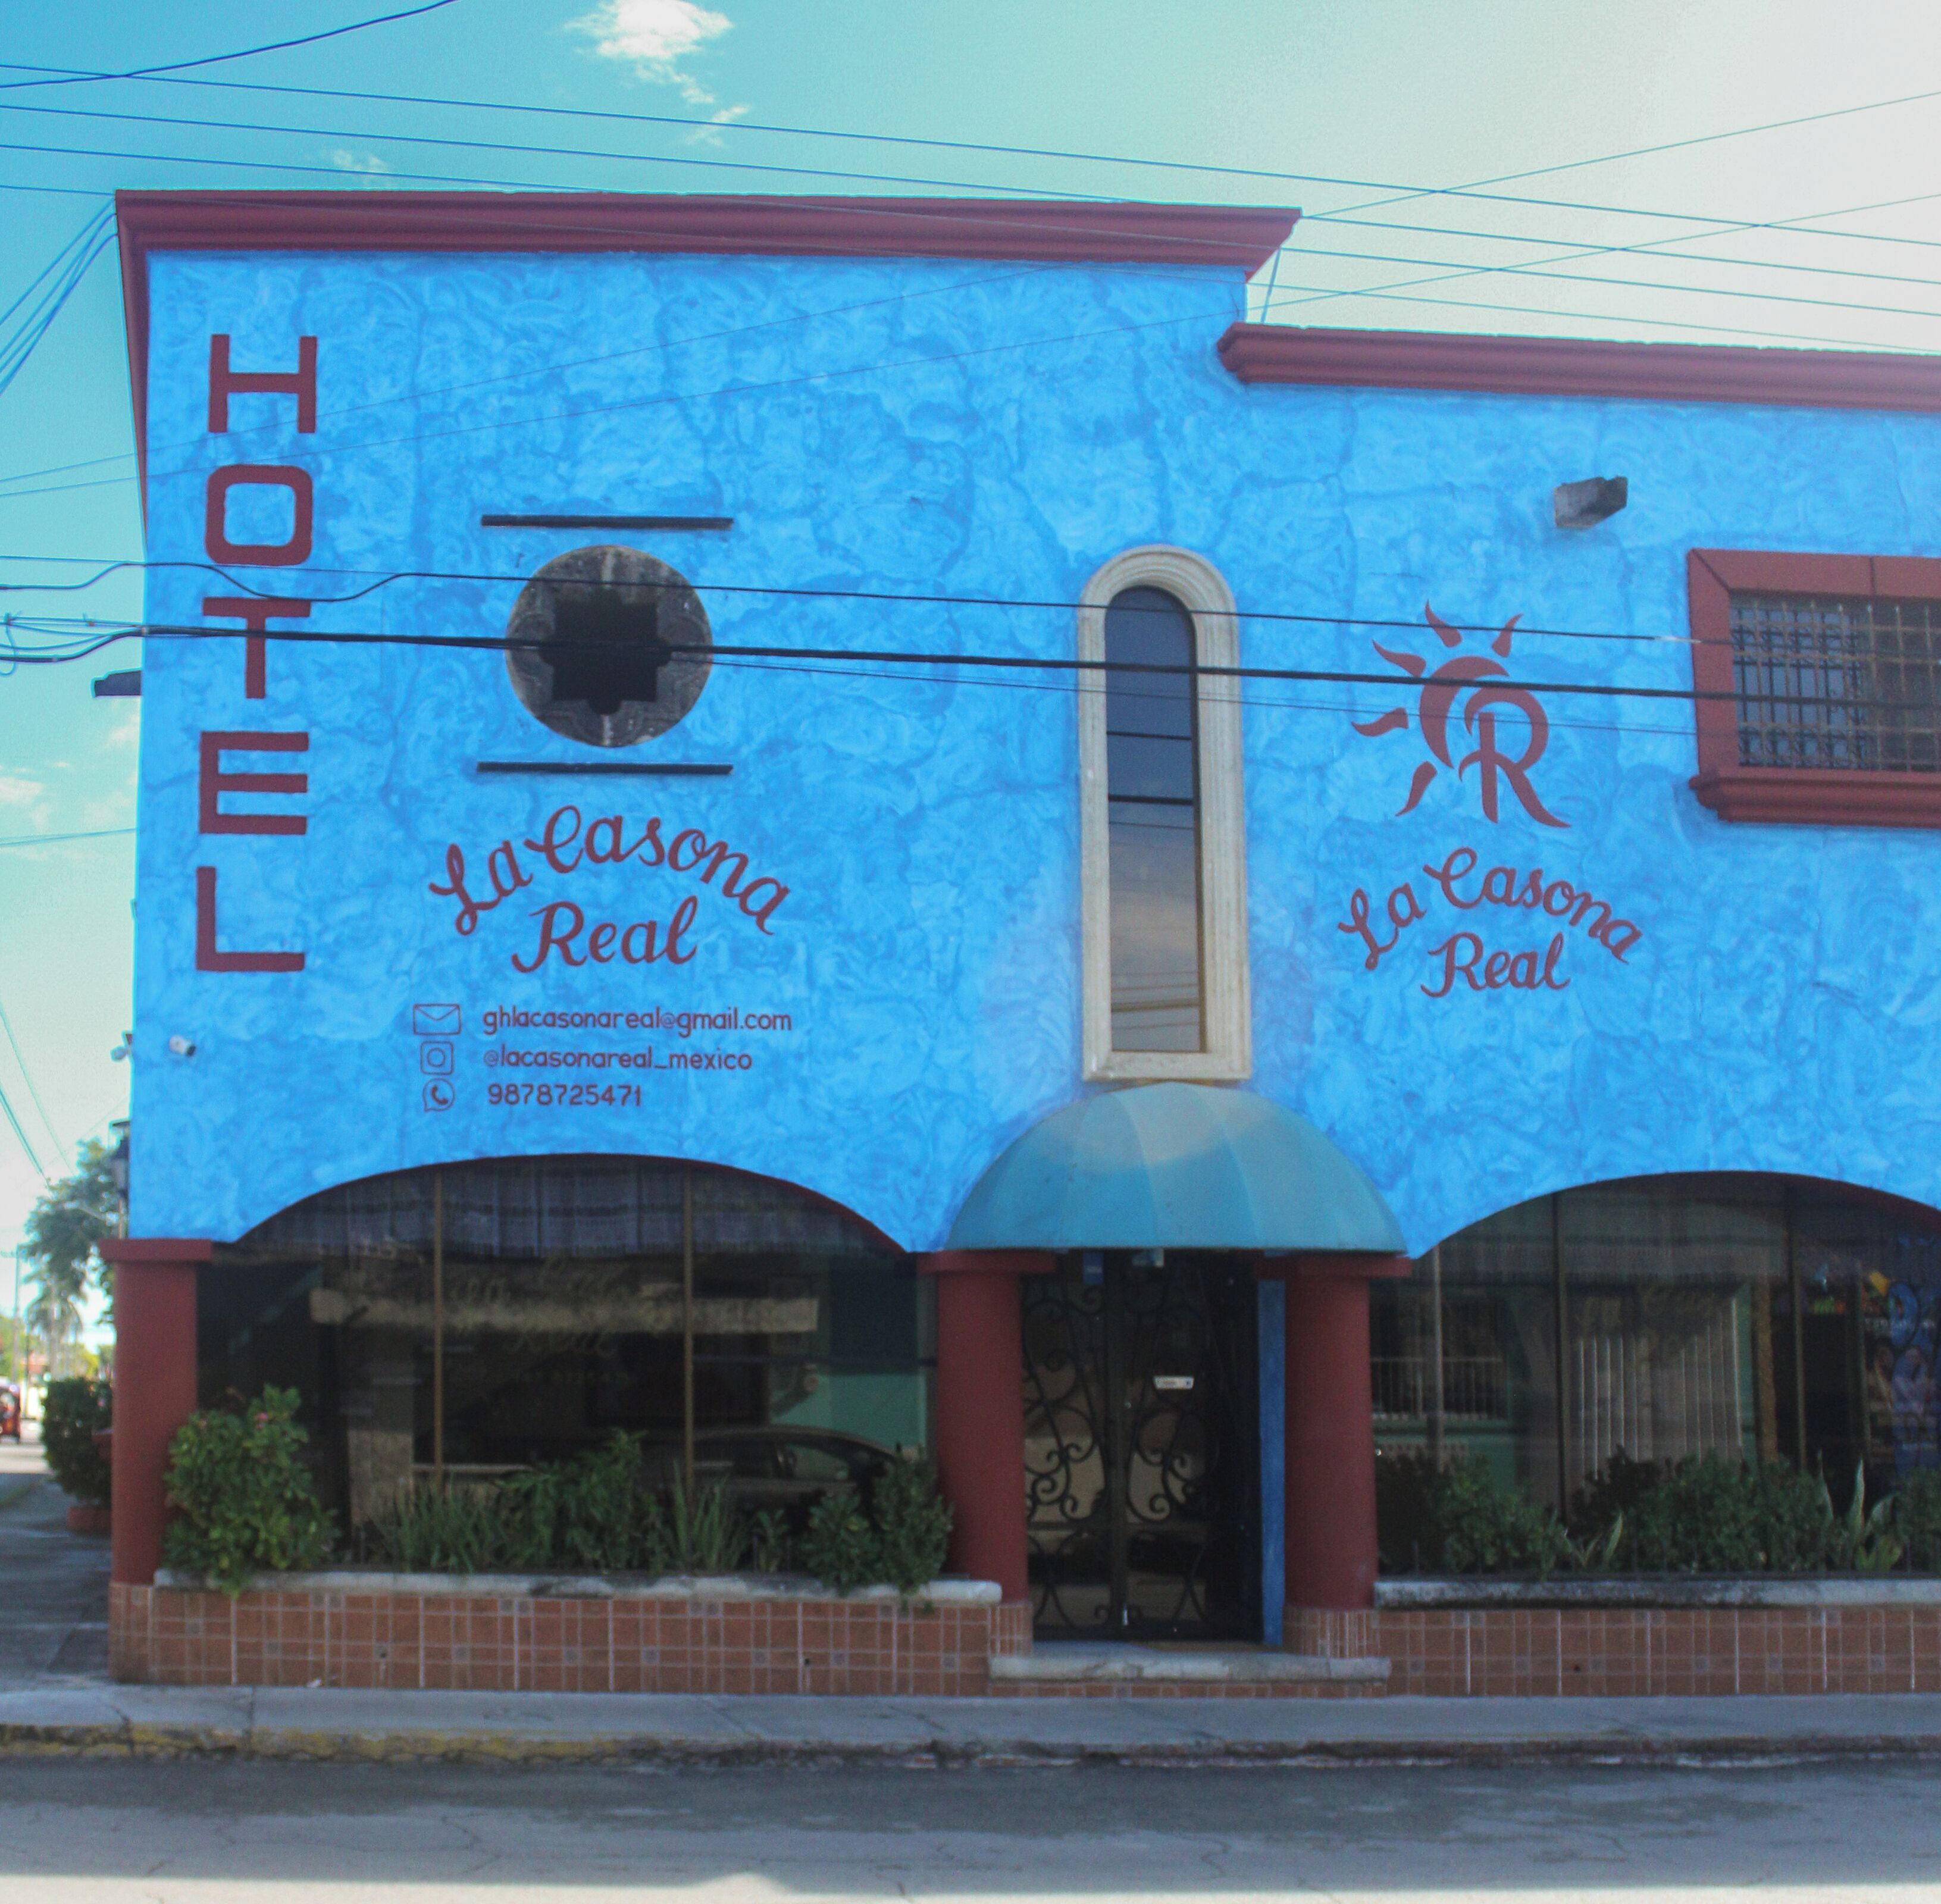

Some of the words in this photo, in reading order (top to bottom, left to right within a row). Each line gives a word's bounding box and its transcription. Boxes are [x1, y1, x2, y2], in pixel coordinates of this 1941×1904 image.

[195, 333, 318, 972] HOTEL
[428, 839, 533, 936] La
[523, 805, 791, 935] Casona
[511, 895, 698, 973] Real
[1338, 882, 1426, 970] La
[1423, 847, 1642, 963] Casona
[1420, 931, 1571, 998] Real
[483, 1005, 792, 1038] ghlacasonareal@gmail.com
[483, 1045, 752, 1070] @lacasonareal_mexico
[489, 1083, 641, 1106] 9878725471
